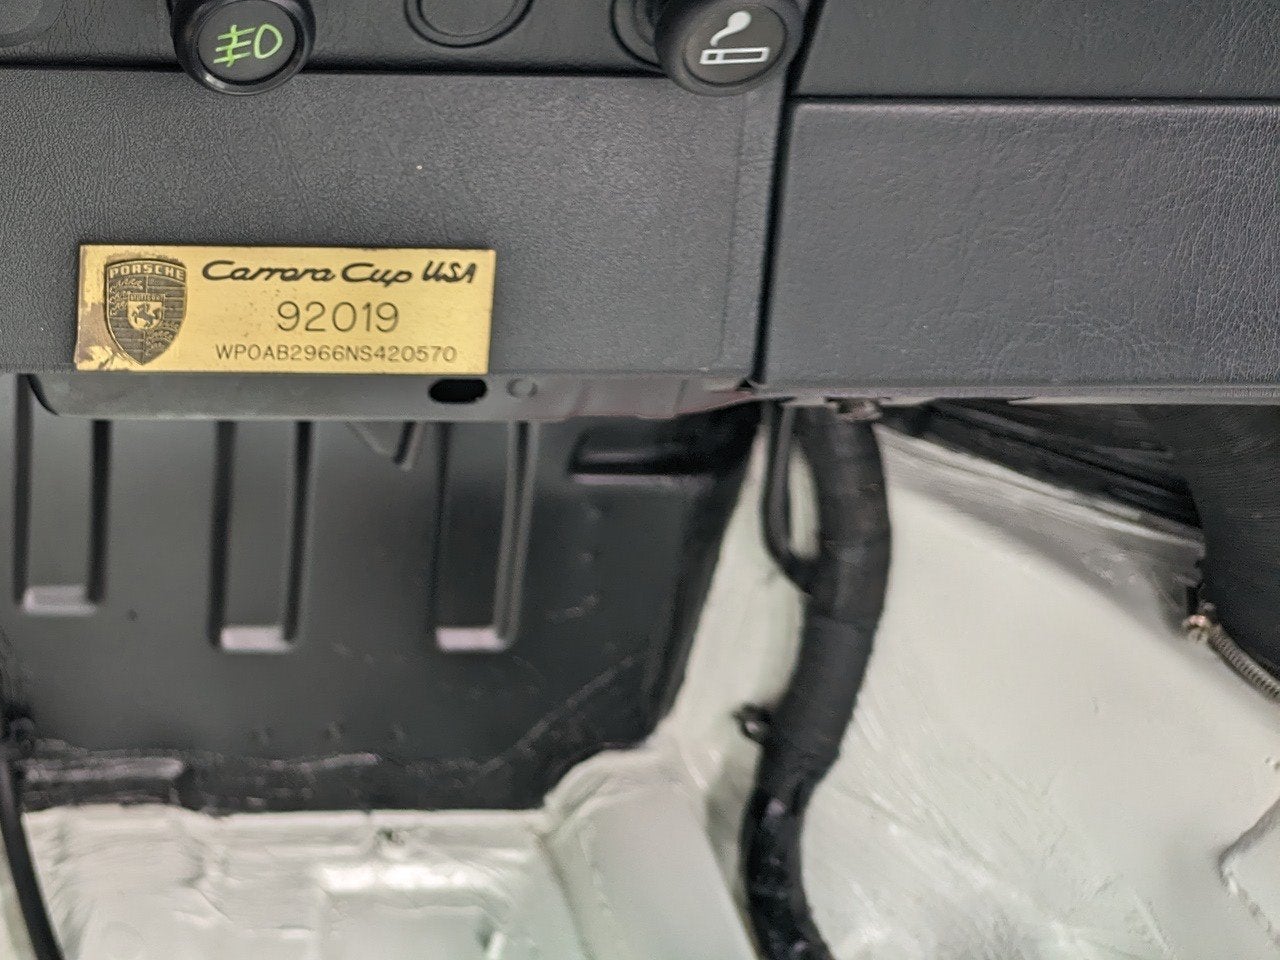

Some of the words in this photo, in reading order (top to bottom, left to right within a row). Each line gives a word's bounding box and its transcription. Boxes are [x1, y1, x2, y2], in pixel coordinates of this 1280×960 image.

[109, 263, 185, 281] PORSCHE
[341, 262, 413, 287] Cup
[421, 261, 477, 284] USA
[276, 300, 400, 334] 92019
